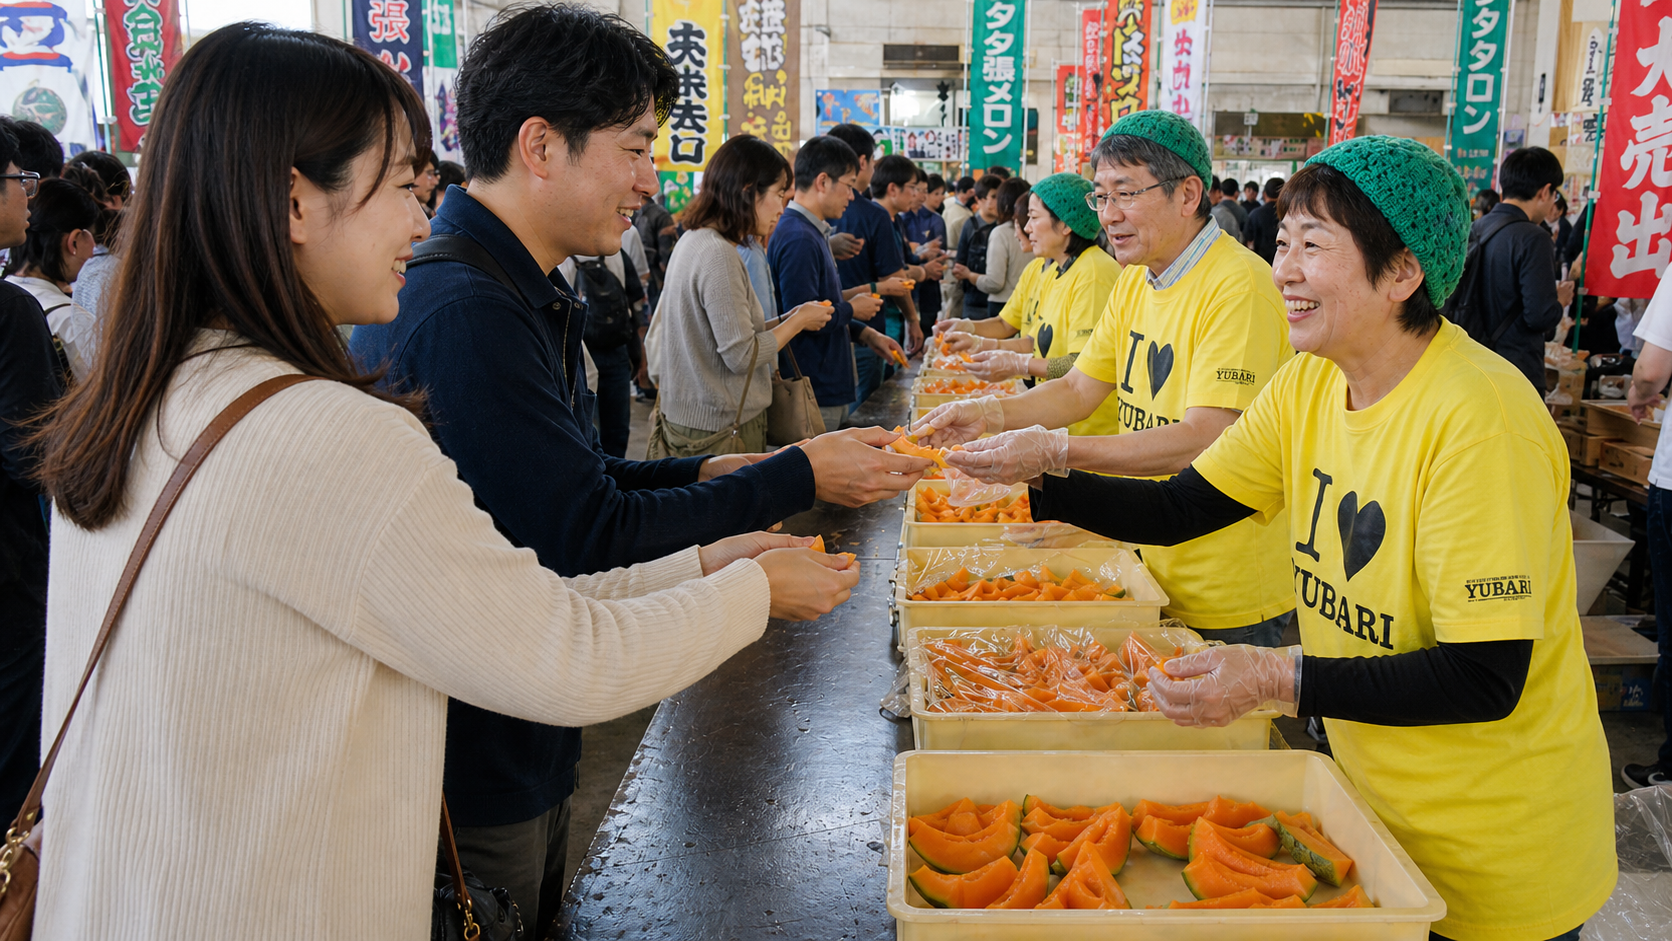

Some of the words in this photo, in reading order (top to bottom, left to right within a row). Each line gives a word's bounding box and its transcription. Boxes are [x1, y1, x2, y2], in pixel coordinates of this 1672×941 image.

[1609, 0, 1672, 279] 大売出
[1120, 330, 1145, 394] I
[1216, 370, 1255, 383] YUBARI
[1117, 396, 1180, 432] YUBA
[1296, 467, 1333, 563] I
[1464, 580, 1532, 598] YUBARI
